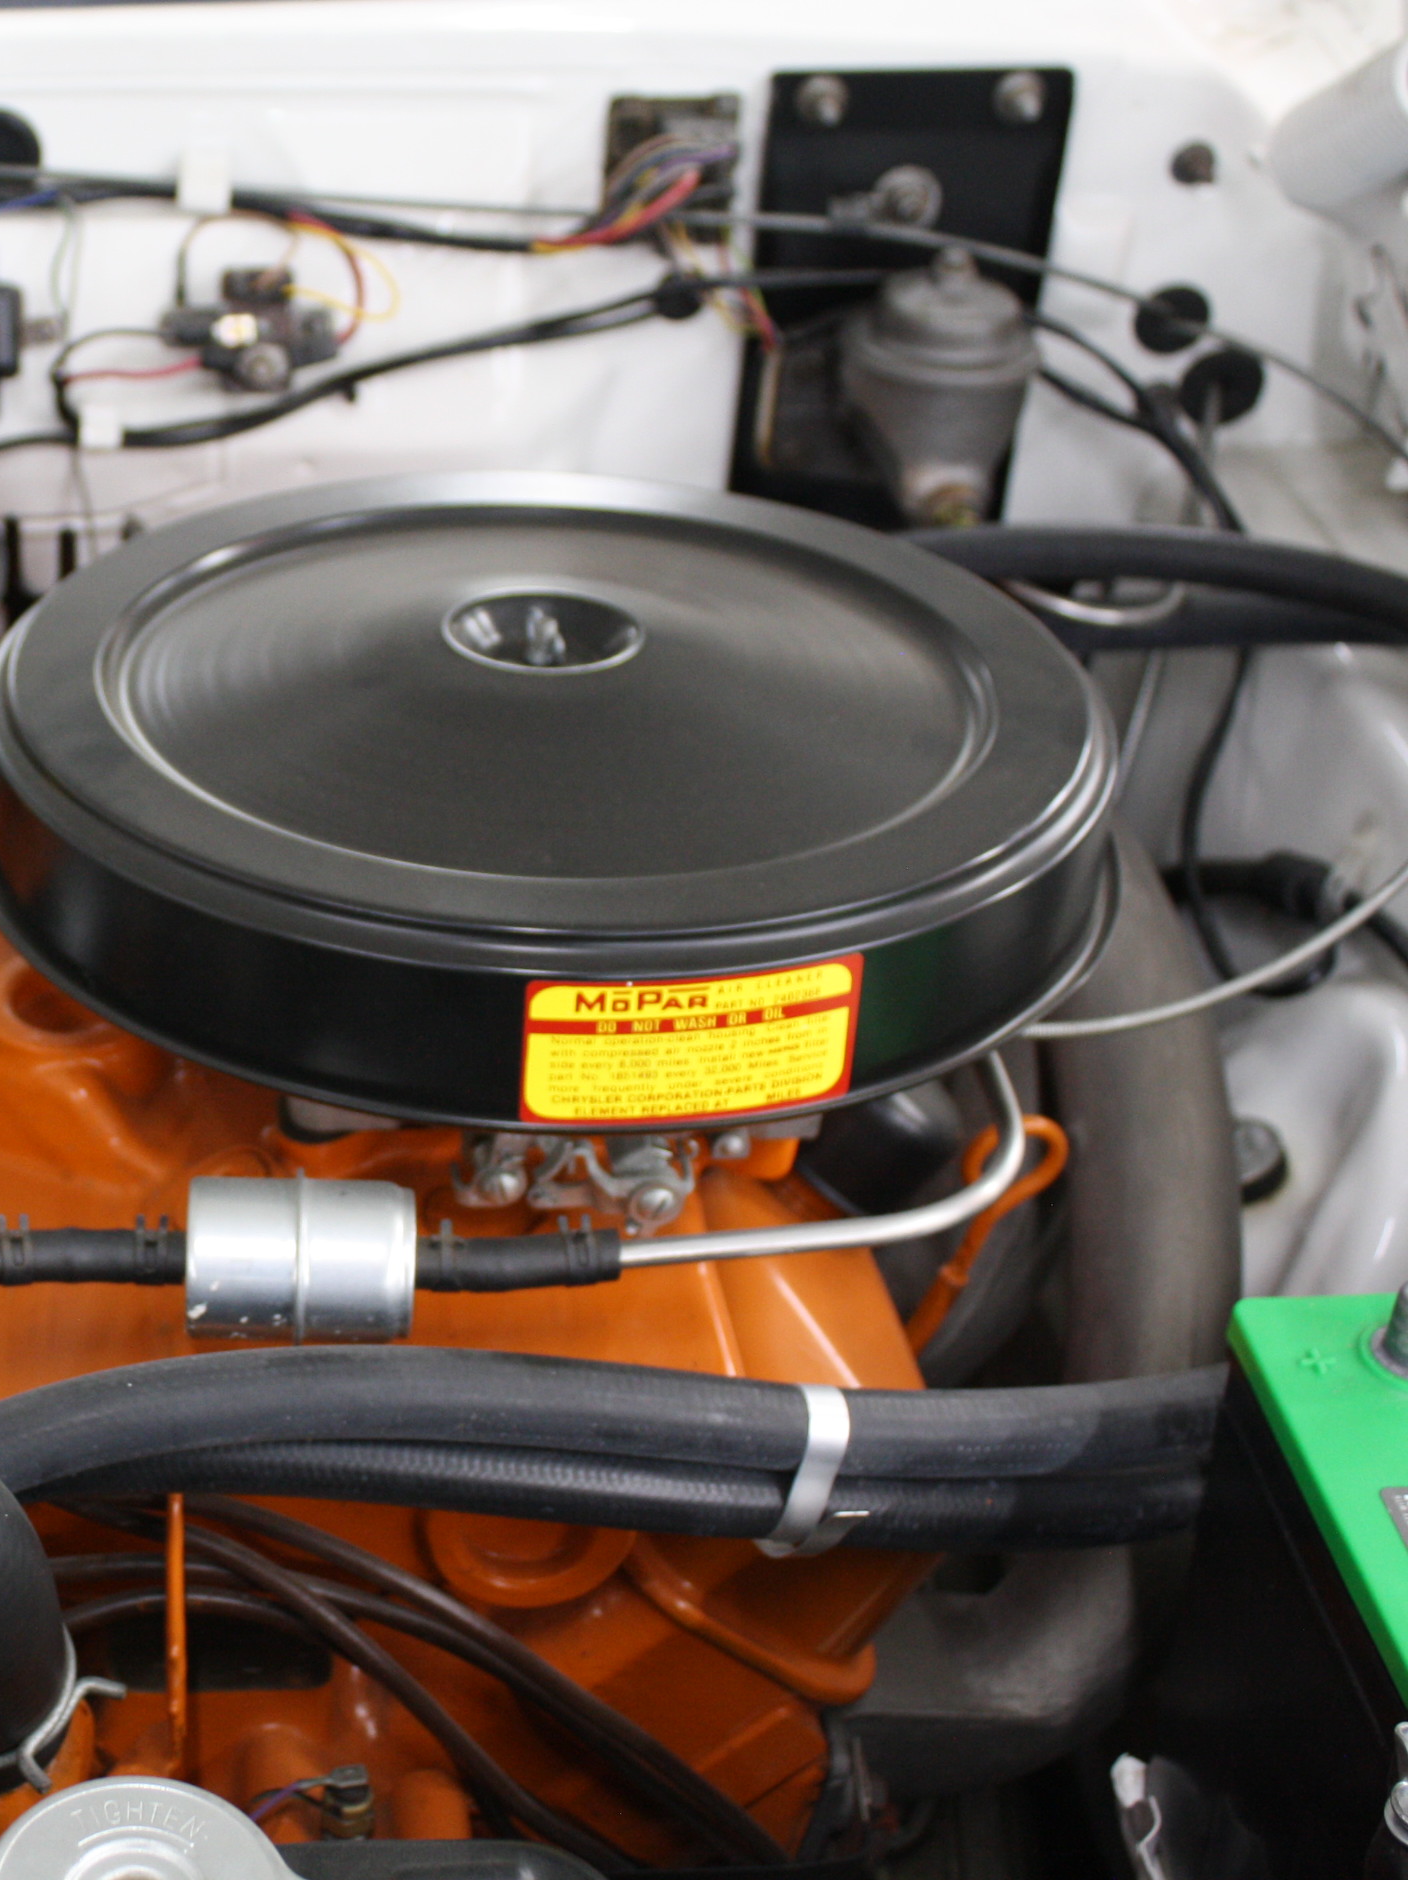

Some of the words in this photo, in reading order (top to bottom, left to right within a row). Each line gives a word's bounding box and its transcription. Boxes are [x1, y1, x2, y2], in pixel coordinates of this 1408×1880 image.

[717, 983, 743, 994] AIR
[756, 970, 823, 990] CLEANER
[715, 998, 744, 1009] PART
[596, 1020, 617, 1033] DO
[632, 1019, 660, 1032] NOT
[674, 1015, 717, 1031] WASH
[727, 1011, 747, 1025] OR
[762, 1006, 786, 1021] OIL
[550, 1048, 576, 1057] with
[583, 1047, 659, 1058] compressed
[743, 1035, 781, 1047] inches
[787, 1029, 811, 1041] from
[551, 1035, 596, 1045] Normal
[581, 1060, 613, 1071] every
[742, 1049, 764, 1059] new
[665, 1069, 697, 1080] every
[669, 1078, 703, 1090] under
[551, 1093, 623, 1104] CHRYSLER
[771, 1072, 823, 1088] DIVISION
[574, 1105, 634, 1116] ELEMENT
[642, 1101, 709, 1114] REPLACED
[714, 1097, 730, 1108] AT
[766, 1088, 802, 1102] MILES
[70, 1799, 206, 1839] TIGHTEN
